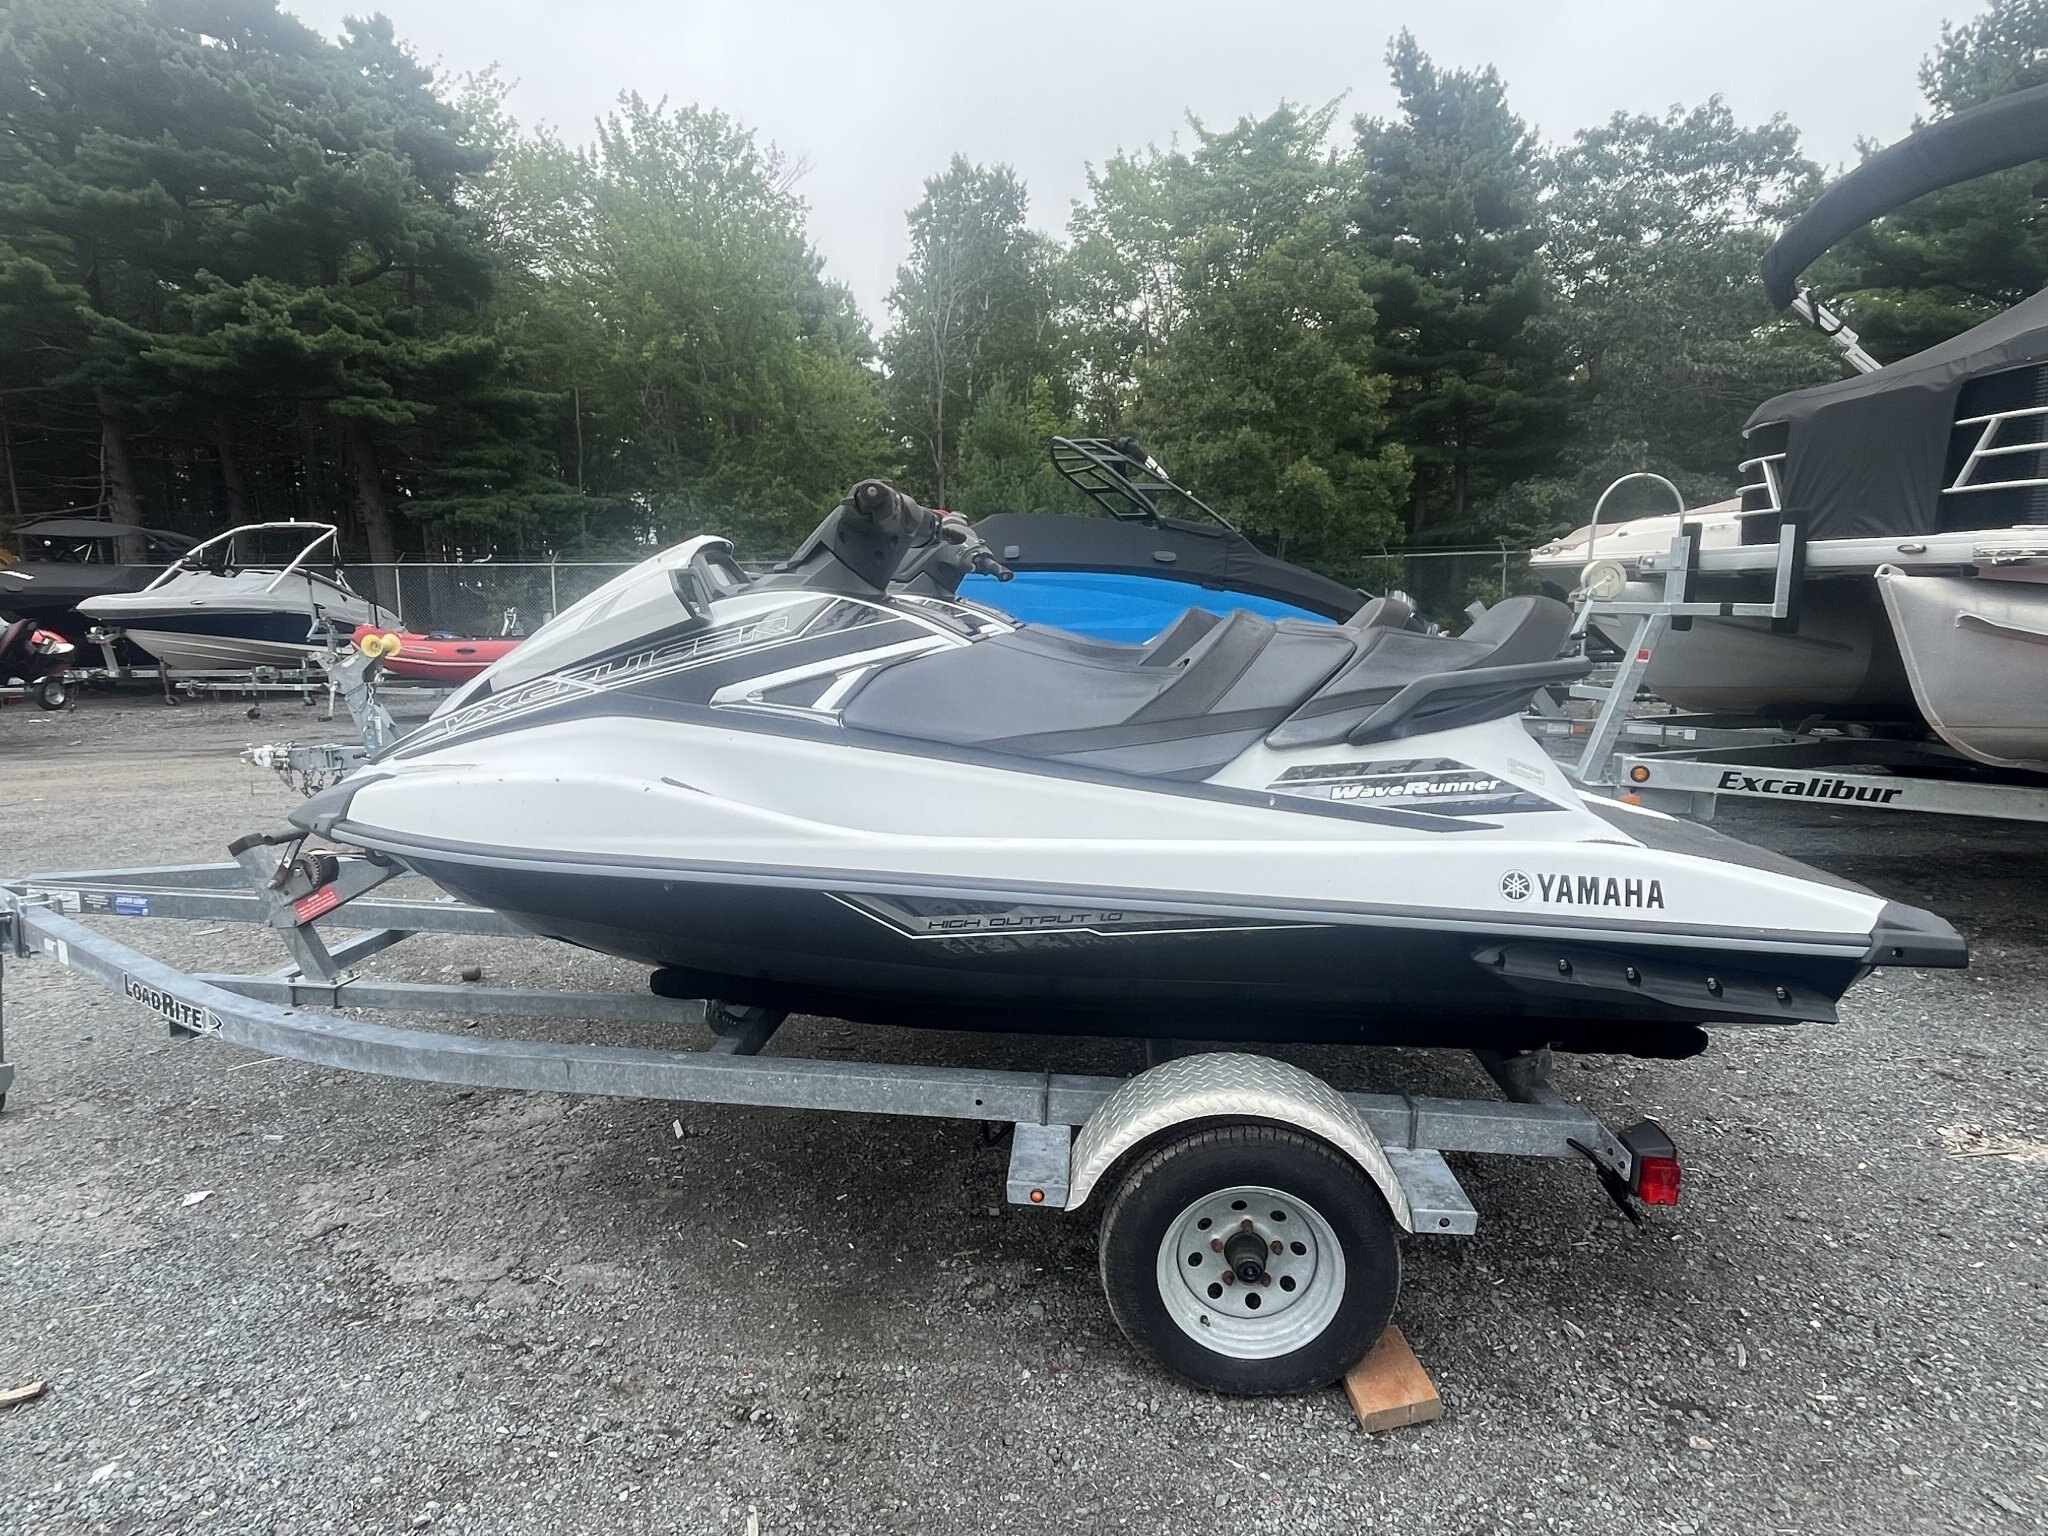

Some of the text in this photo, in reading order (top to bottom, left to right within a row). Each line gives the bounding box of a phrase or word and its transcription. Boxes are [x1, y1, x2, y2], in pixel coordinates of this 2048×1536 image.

[1331, 779, 1501, 800] WaveRunner
[1718, 771, 1902, 803] Excalibur
[1537, 873, 1665, 909] YAMAHA
[928, 919, 981, 929] HIGH
[989, 914, 1091, 926] OUTPUT
